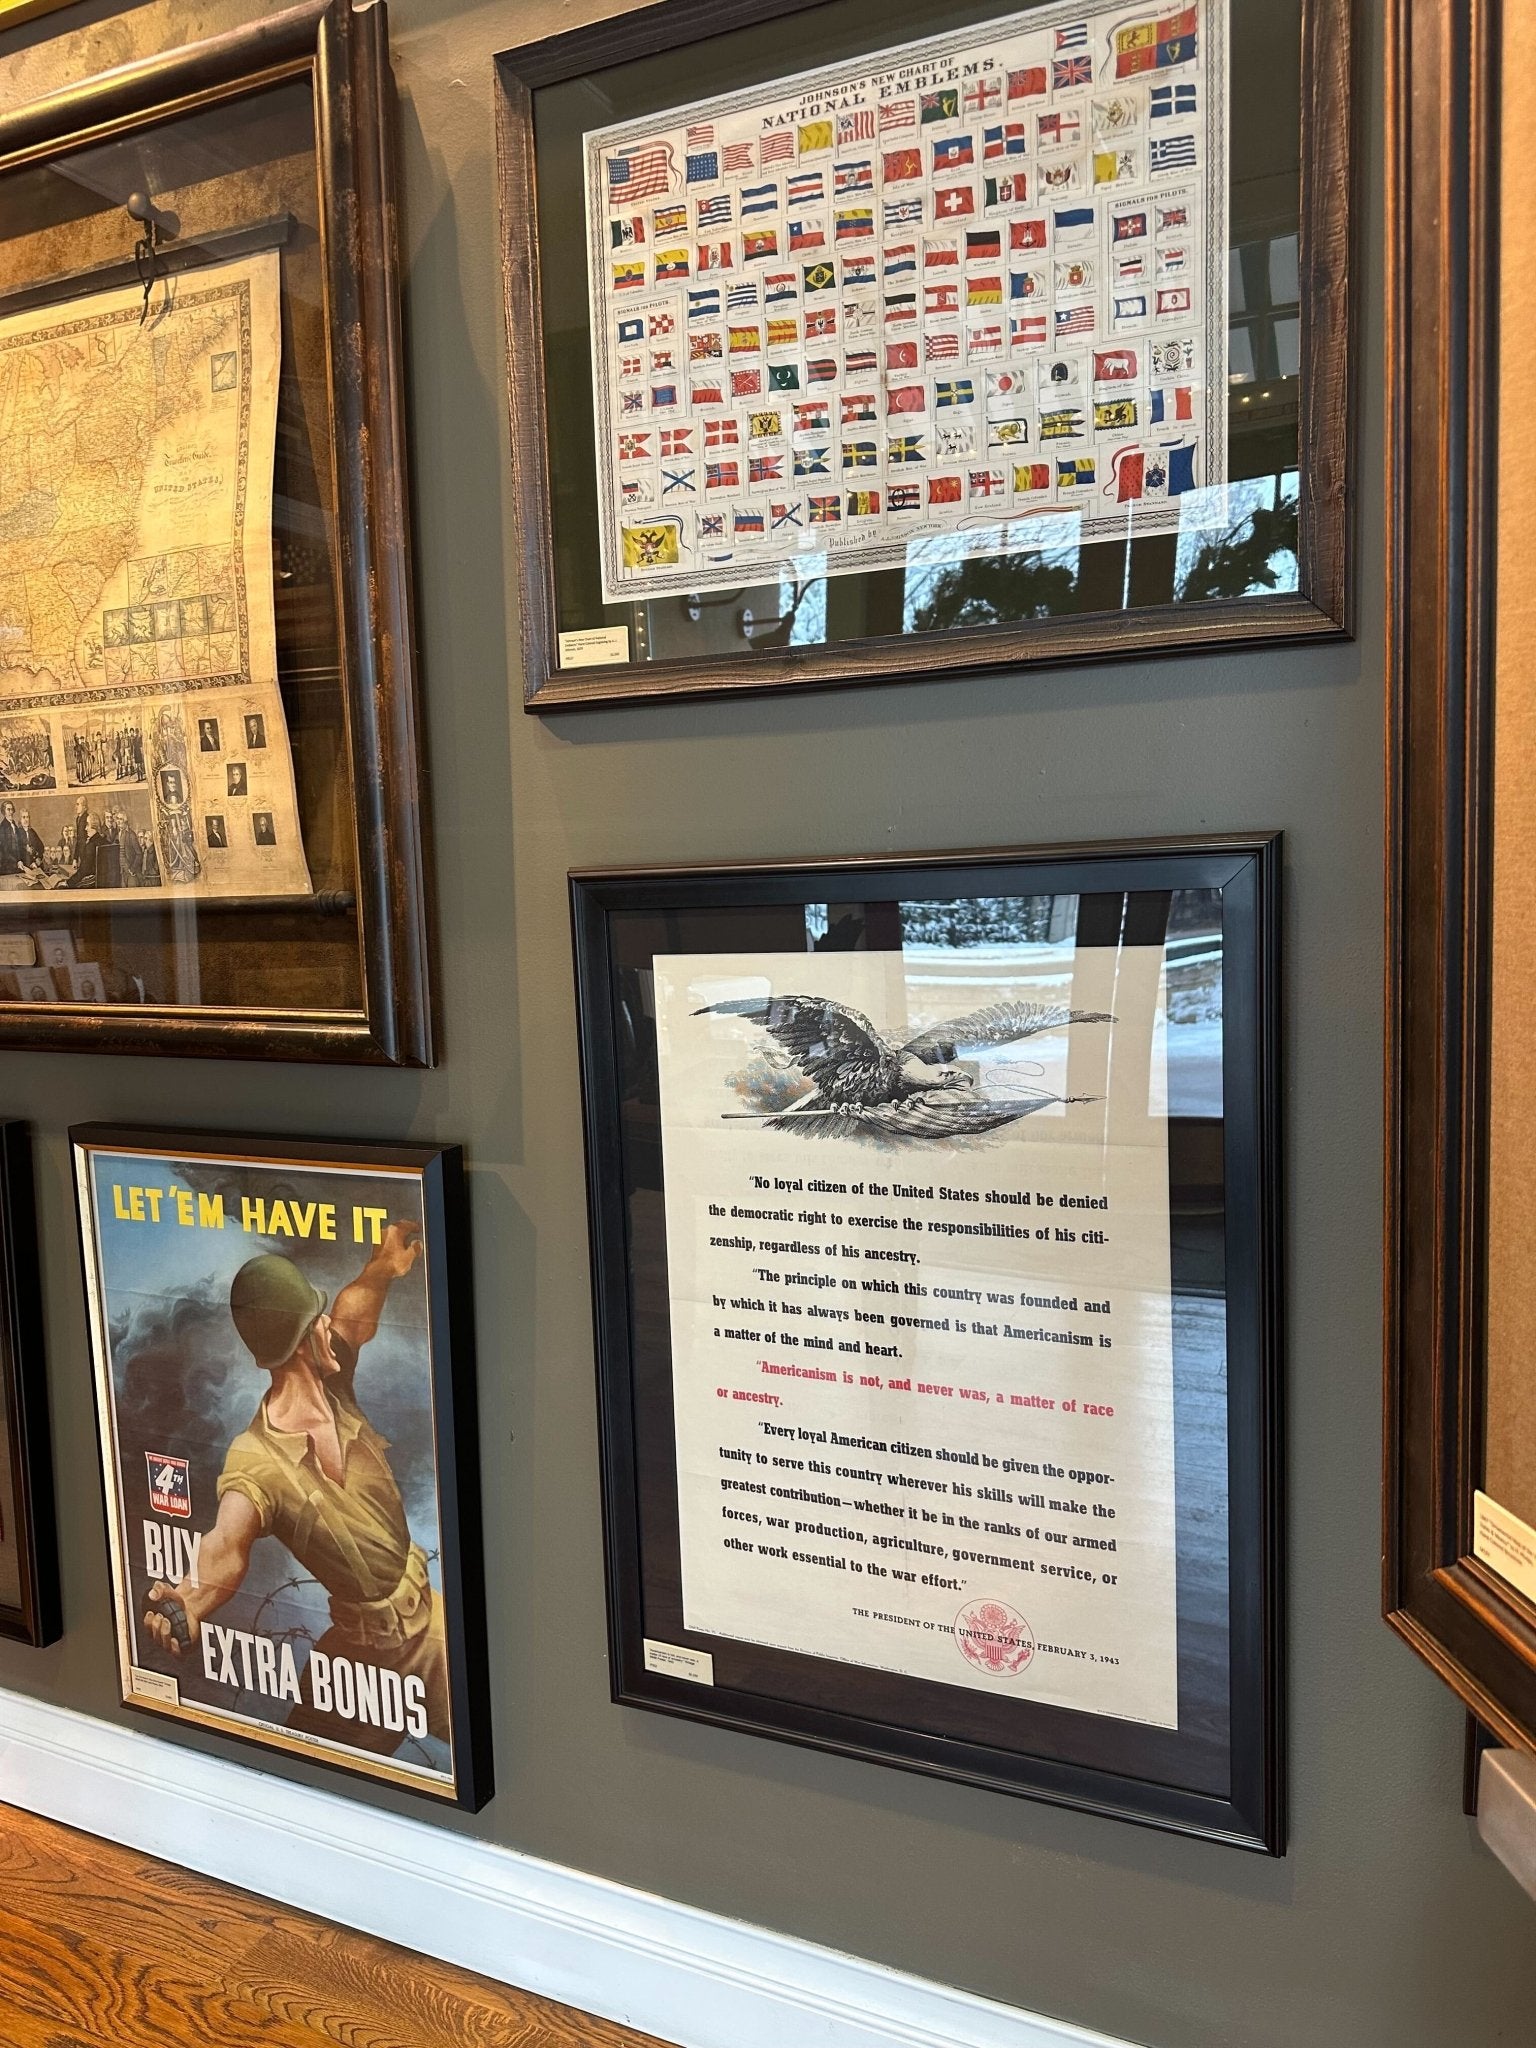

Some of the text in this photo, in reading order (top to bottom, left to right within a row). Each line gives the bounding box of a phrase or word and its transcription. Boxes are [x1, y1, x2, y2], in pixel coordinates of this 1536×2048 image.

[799, 56, 956, 105] JOHNSON'S NEW CHART OF
[761, 93, 867, 130] NATIONAL
[828, 533, 866, 548] Published
[867, 528, 878, 538] by
[113, 1184, 163, 1222] LET
[241, 1196, 337, 1241] HAVE
[353, 1206, 387, 1245] IT
[773, 1176, 804, 1193] loyal
[806, 1178, 847, 1194] citizen
[850, 1181, 864, 1195] of
[867, 1182, 889, 1196] the
[890, 1183, 934, 1201] United
[938, 1185, 980, 1202] States
[984, 1189, 1031, 1205] should
[1035, 1191, 1054, 1207] be
[1058, 1193, 1108, 1210] denied
[707, 1203, 1109, 1244] the democratic right to exercise the responsibilities of his citi-
[709, 1235, 921, 1266] zenship, regardless of his ancestry.
[783, 1271, 836, 1289] principle
[840, 1278, 857, 1290] on
[860, 1278, 900, 1294] which
[902, 1281, 928, 1296] this
[932, 1287, 982, 1305] country
[985, 1292, 1014, 1305] was
[1019, 1292, 1078, 1311] founded
[1083, 1299, 1111, 1314] and
[711, 1293, 1112, 1348] by which it has always been governed is that Americanism is
[712, 1326, 903, 1358] a matter of the mind and heart.
[716, 1387, 783, 1408] or ancestry.
[842, 1370, 854, 1384] is
[859, 1375, 883, 1390] not,
[887, 1377, 911, 1391] and
[916, 1382, 954, 1397] never
[958, 1387, 990, 1404] was,
[995, 1392, 1004, 1403] a
[1009, 1394, 1055, 1409] matter
[1061, 1398, 1076, 1412] of
[1082, 1403, 1114, 1417] race
[796, 1426, 827, 1444] loyal
[829, 1431, 887, 1452] American
[889, 1440, 933, 1459] citizen
[934, 1447, 980, 1466] should
[981, 1453, 999, 1469] be
[1001, 1457, 1039, 1475] given
[1041, 1462, 1065, 1478] the
[1067, 1468, 1115, 1485] oppor-
[152, 1491, 189, 1511] WAR LOAN
[718, 1445, 1116, 1519] tunity to serve this country wherever his skills will make the
[720, 1477, 767, 1495] greatest
[907, 1505, 918, 1520] it
[920, 1507, 938, 1523] be
[941, 1511, 955, 1526] in
[957, 1514, 980, 1530] the
[983, 1521, 1021, 1537] ranks
[1024, 1526, 1040, 1540] of
[1043, 1531, 1068, 1545] our
[1071, 1535, 1117, 1552] armed
[142, 1519, 202, 1588] BUY
[721, 1505, 1117, 1585] forces, war production, agriculture, government service, or
[722, 1536, 754, 1553] other
[756, 1544, 788, 1559] work
[791, 1550, 846, 1570] essential
[849, 1559, 863, 1573] to
[866, 1562, 887, 1577] the
[890, 1568, 917, 1583] war
[851, 1607, 1119, 1665] THE PRESIDENT OF THE UNITED STATES, FEBRUARY 3, 1943
[200, 1621, 428, 1739] EXTRA BONDS
